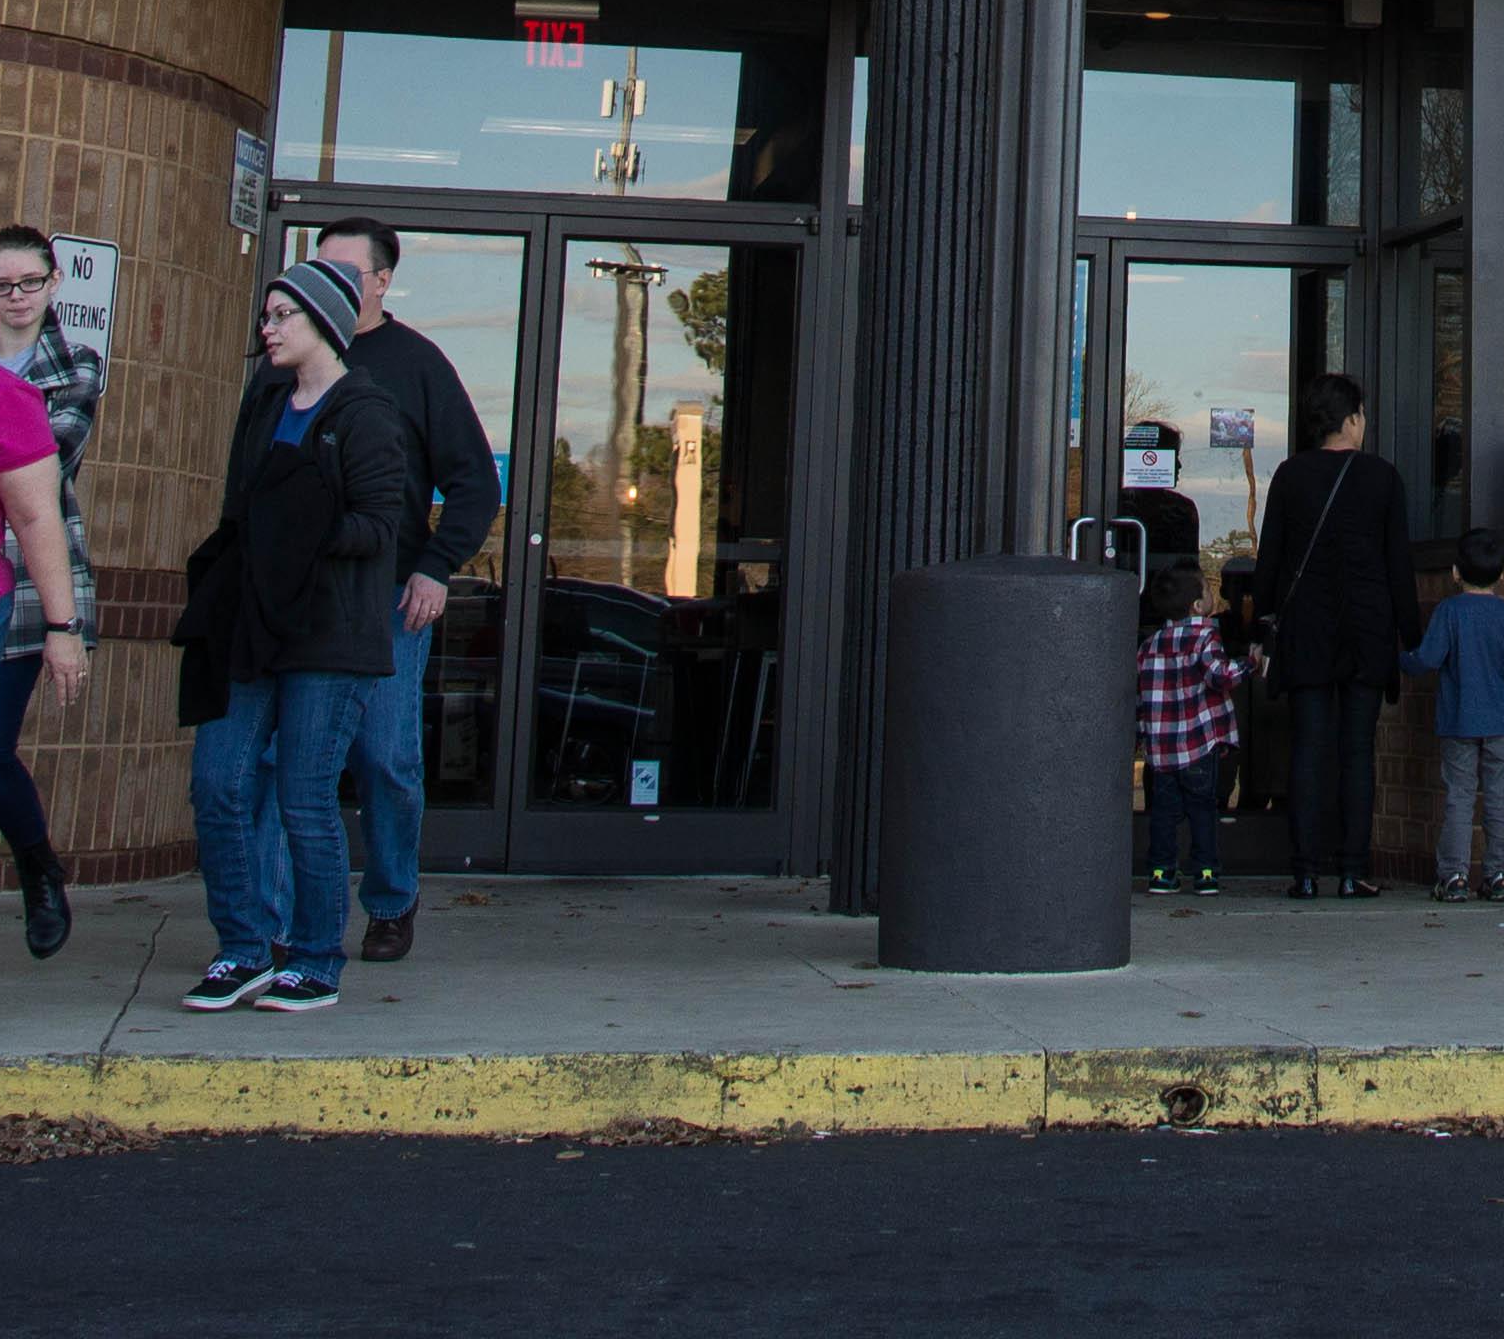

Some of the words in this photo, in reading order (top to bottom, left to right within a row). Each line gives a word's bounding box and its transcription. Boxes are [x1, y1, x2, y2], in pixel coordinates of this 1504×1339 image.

[239, 139, 265, 168] NOTICE
[72, 254, 93, 280] NO
[55, 301, 106, 331] OITERING
